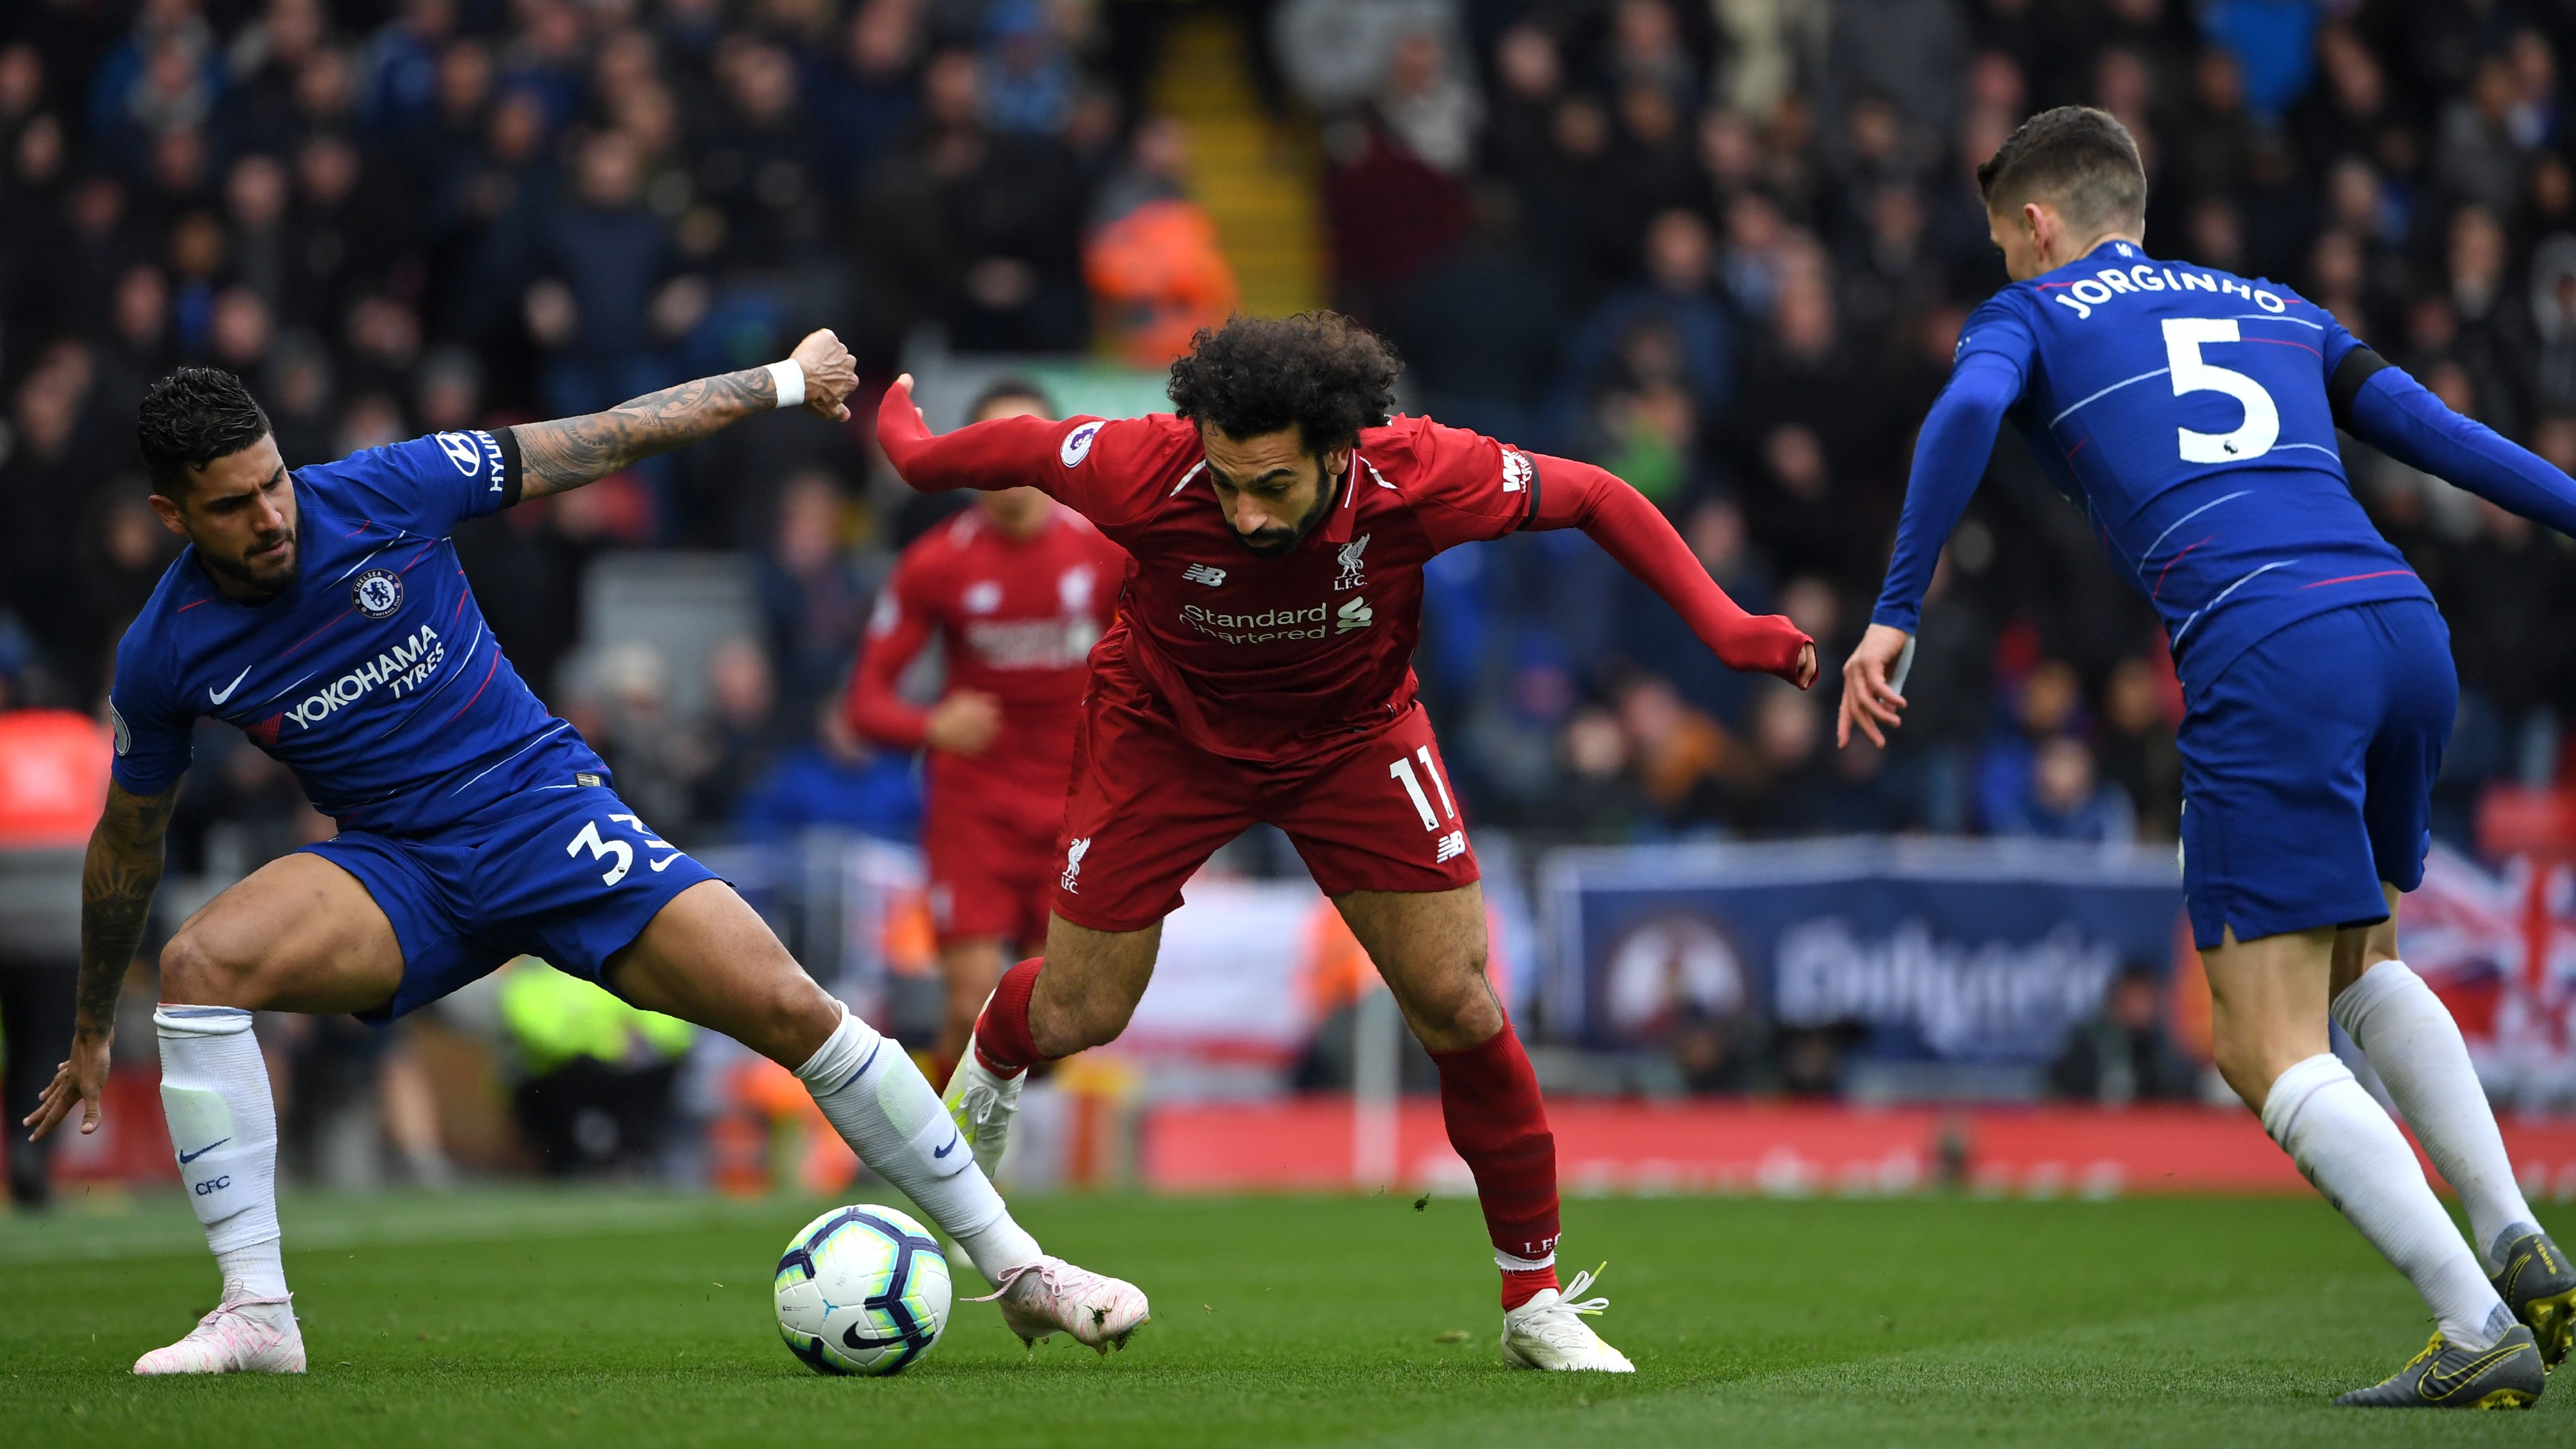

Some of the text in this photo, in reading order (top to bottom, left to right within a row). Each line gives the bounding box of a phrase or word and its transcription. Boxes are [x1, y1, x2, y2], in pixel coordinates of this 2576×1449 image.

[2056, 264, 2285, 320] JORGINHO
[2161, 317, 2280, 464] 5
[354, 570, 381, 593] CHELSEA
[373, 606, 395, 616] FOOTBALL
[1184, 602, 1327, 628] Standard
[284, 624, 438, 730] YOKOHAMA
[389, 641, 444, 699] TYRES
[1389, 745, 1455, 832] 11
[195, 1175, 231, 1196] CFC
